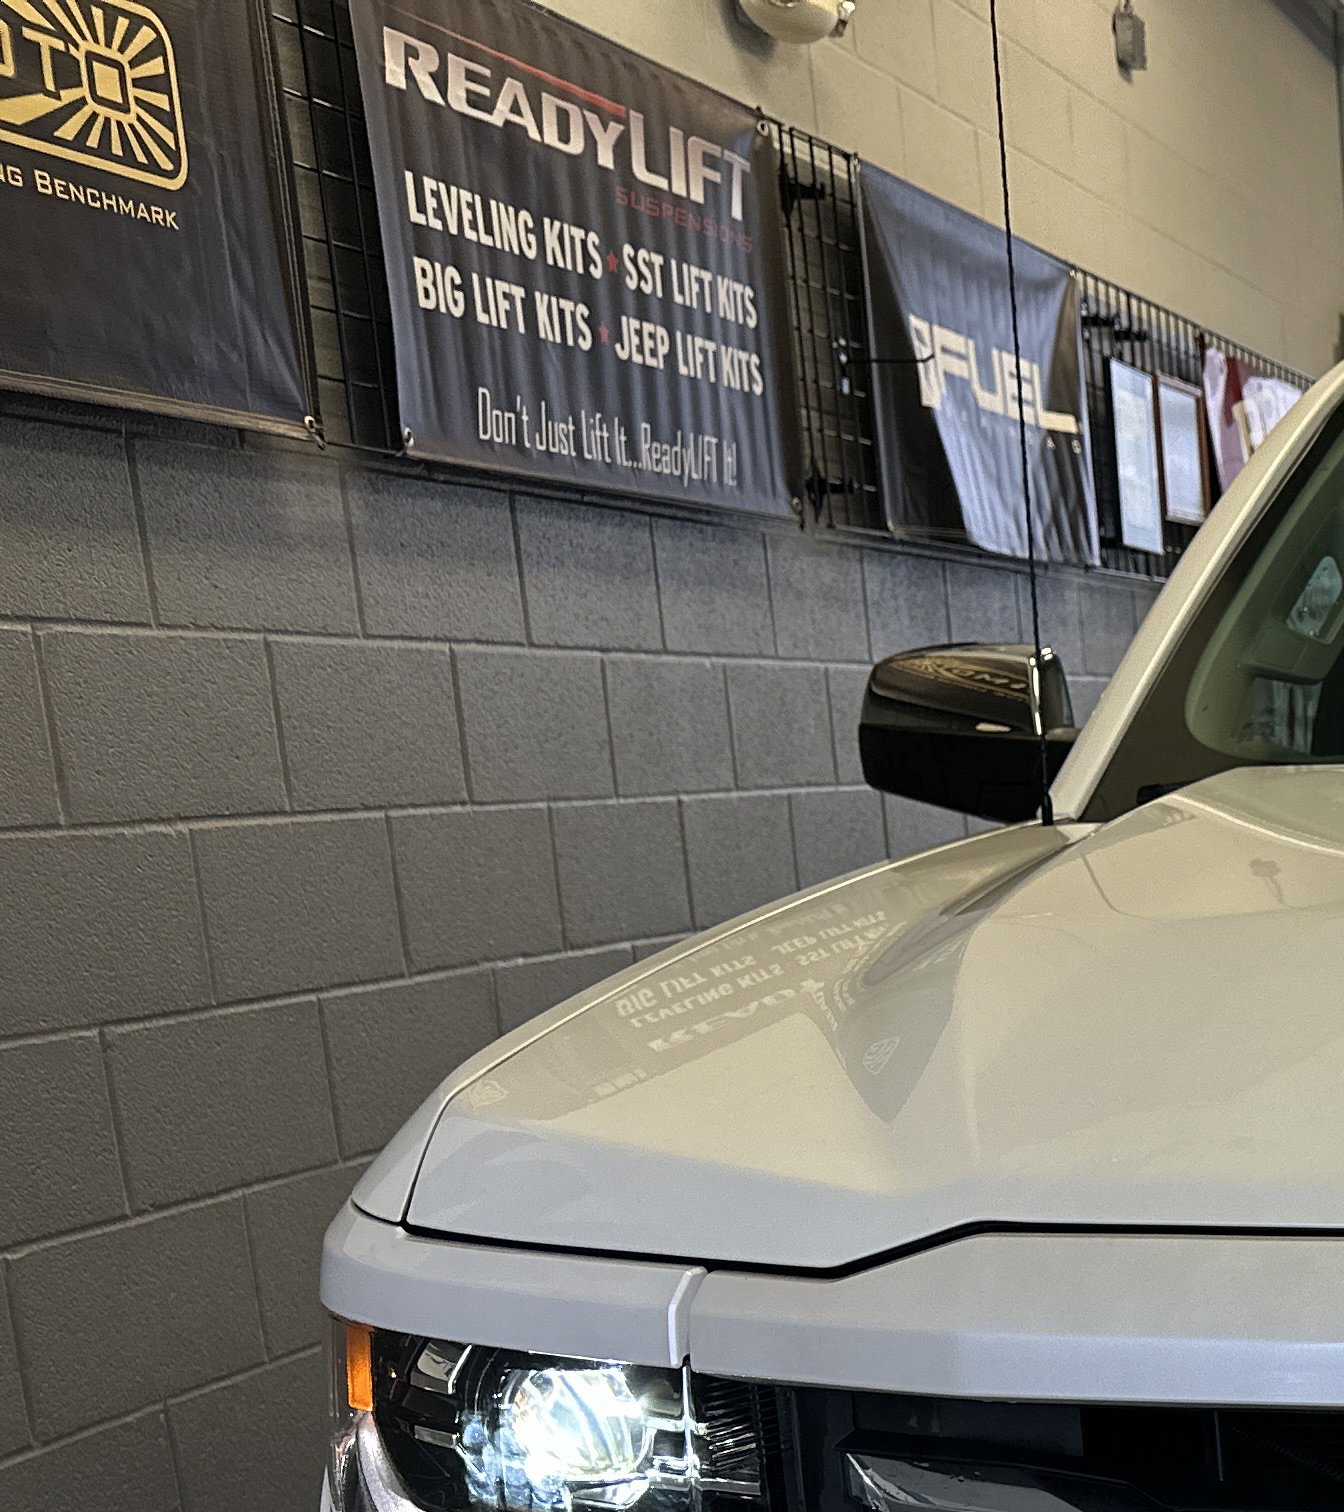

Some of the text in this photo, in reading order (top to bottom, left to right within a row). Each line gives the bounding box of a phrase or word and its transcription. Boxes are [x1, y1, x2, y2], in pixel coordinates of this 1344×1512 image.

[383, 26, 751, 221] READYLIFT
[34, 169, 179, 230] BENCHMARK
[404, 170, 757, 329] LEVELING KITS SST LIFT KITS
[413, 256, 763, 396] BIG LIFT KITS JEEP LIFT KITS
[478, 387, 530, 448] Don't
[536, 400, 576, 457] Just
[581, 409, 612, 463] Lift
